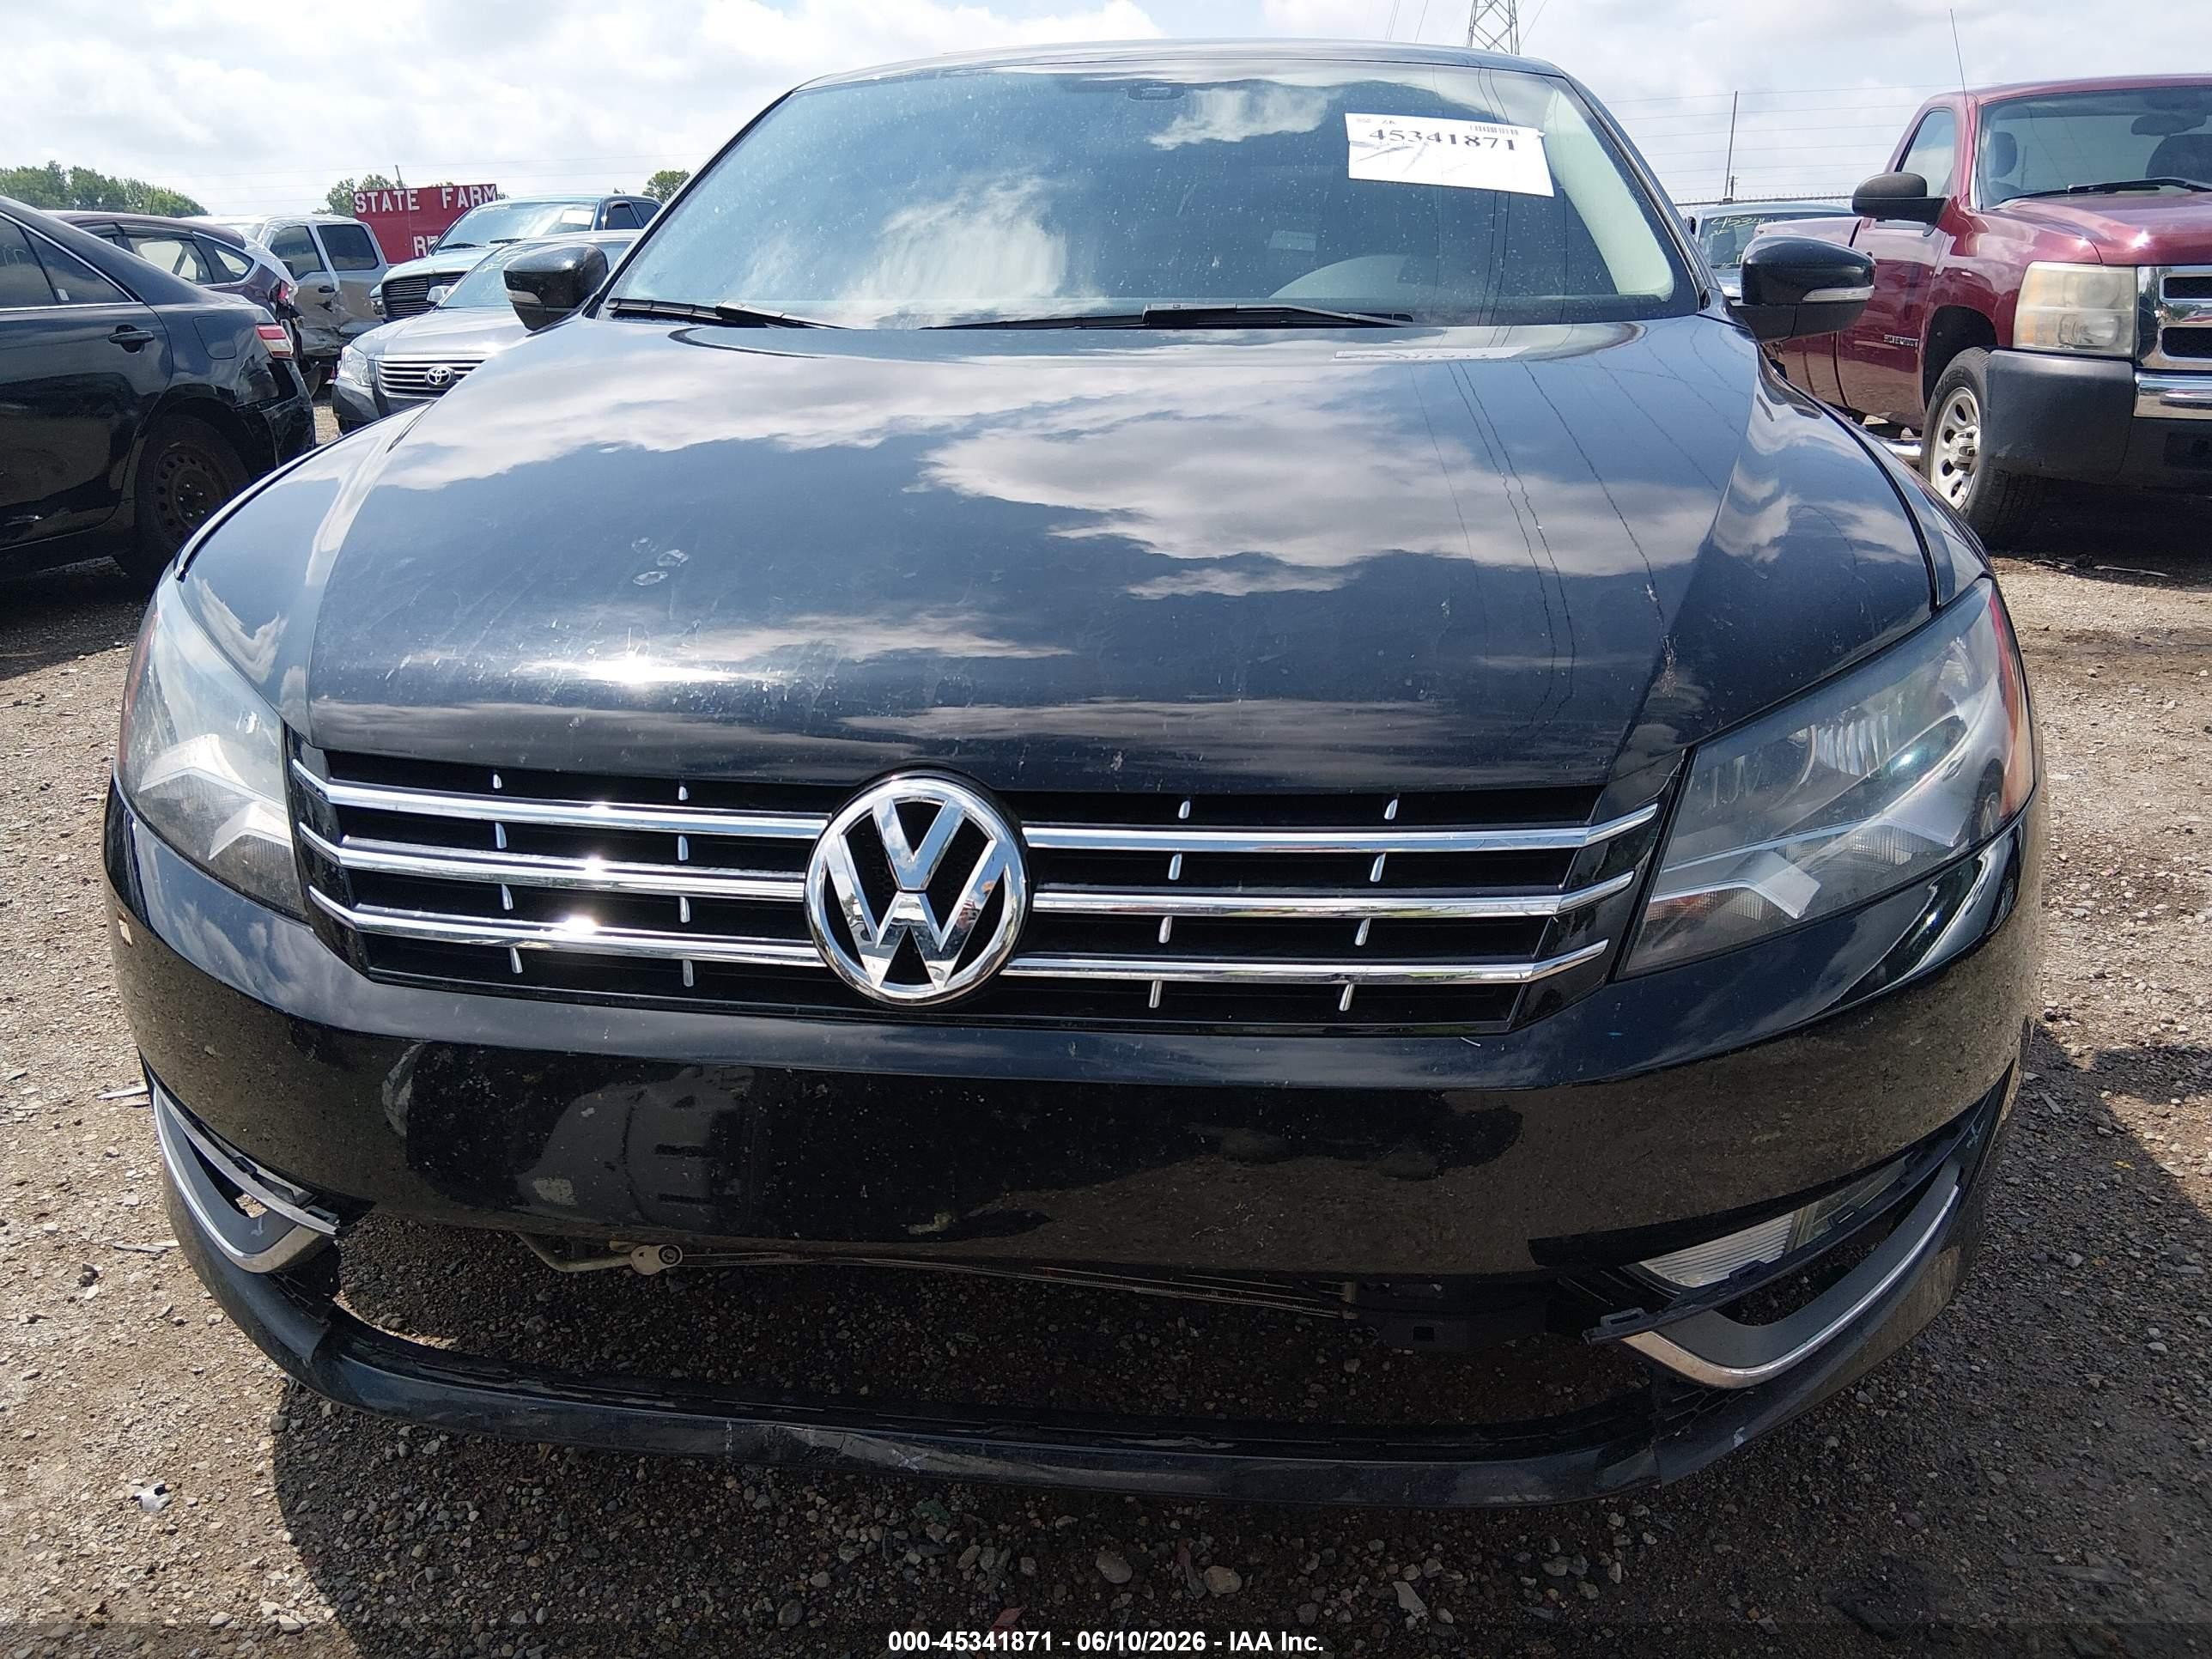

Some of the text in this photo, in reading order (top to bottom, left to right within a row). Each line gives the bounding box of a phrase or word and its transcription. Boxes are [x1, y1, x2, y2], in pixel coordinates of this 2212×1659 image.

[1369, 128, 1517, 151] 45341871
[354, 185, 497, 214] STATE FARM
